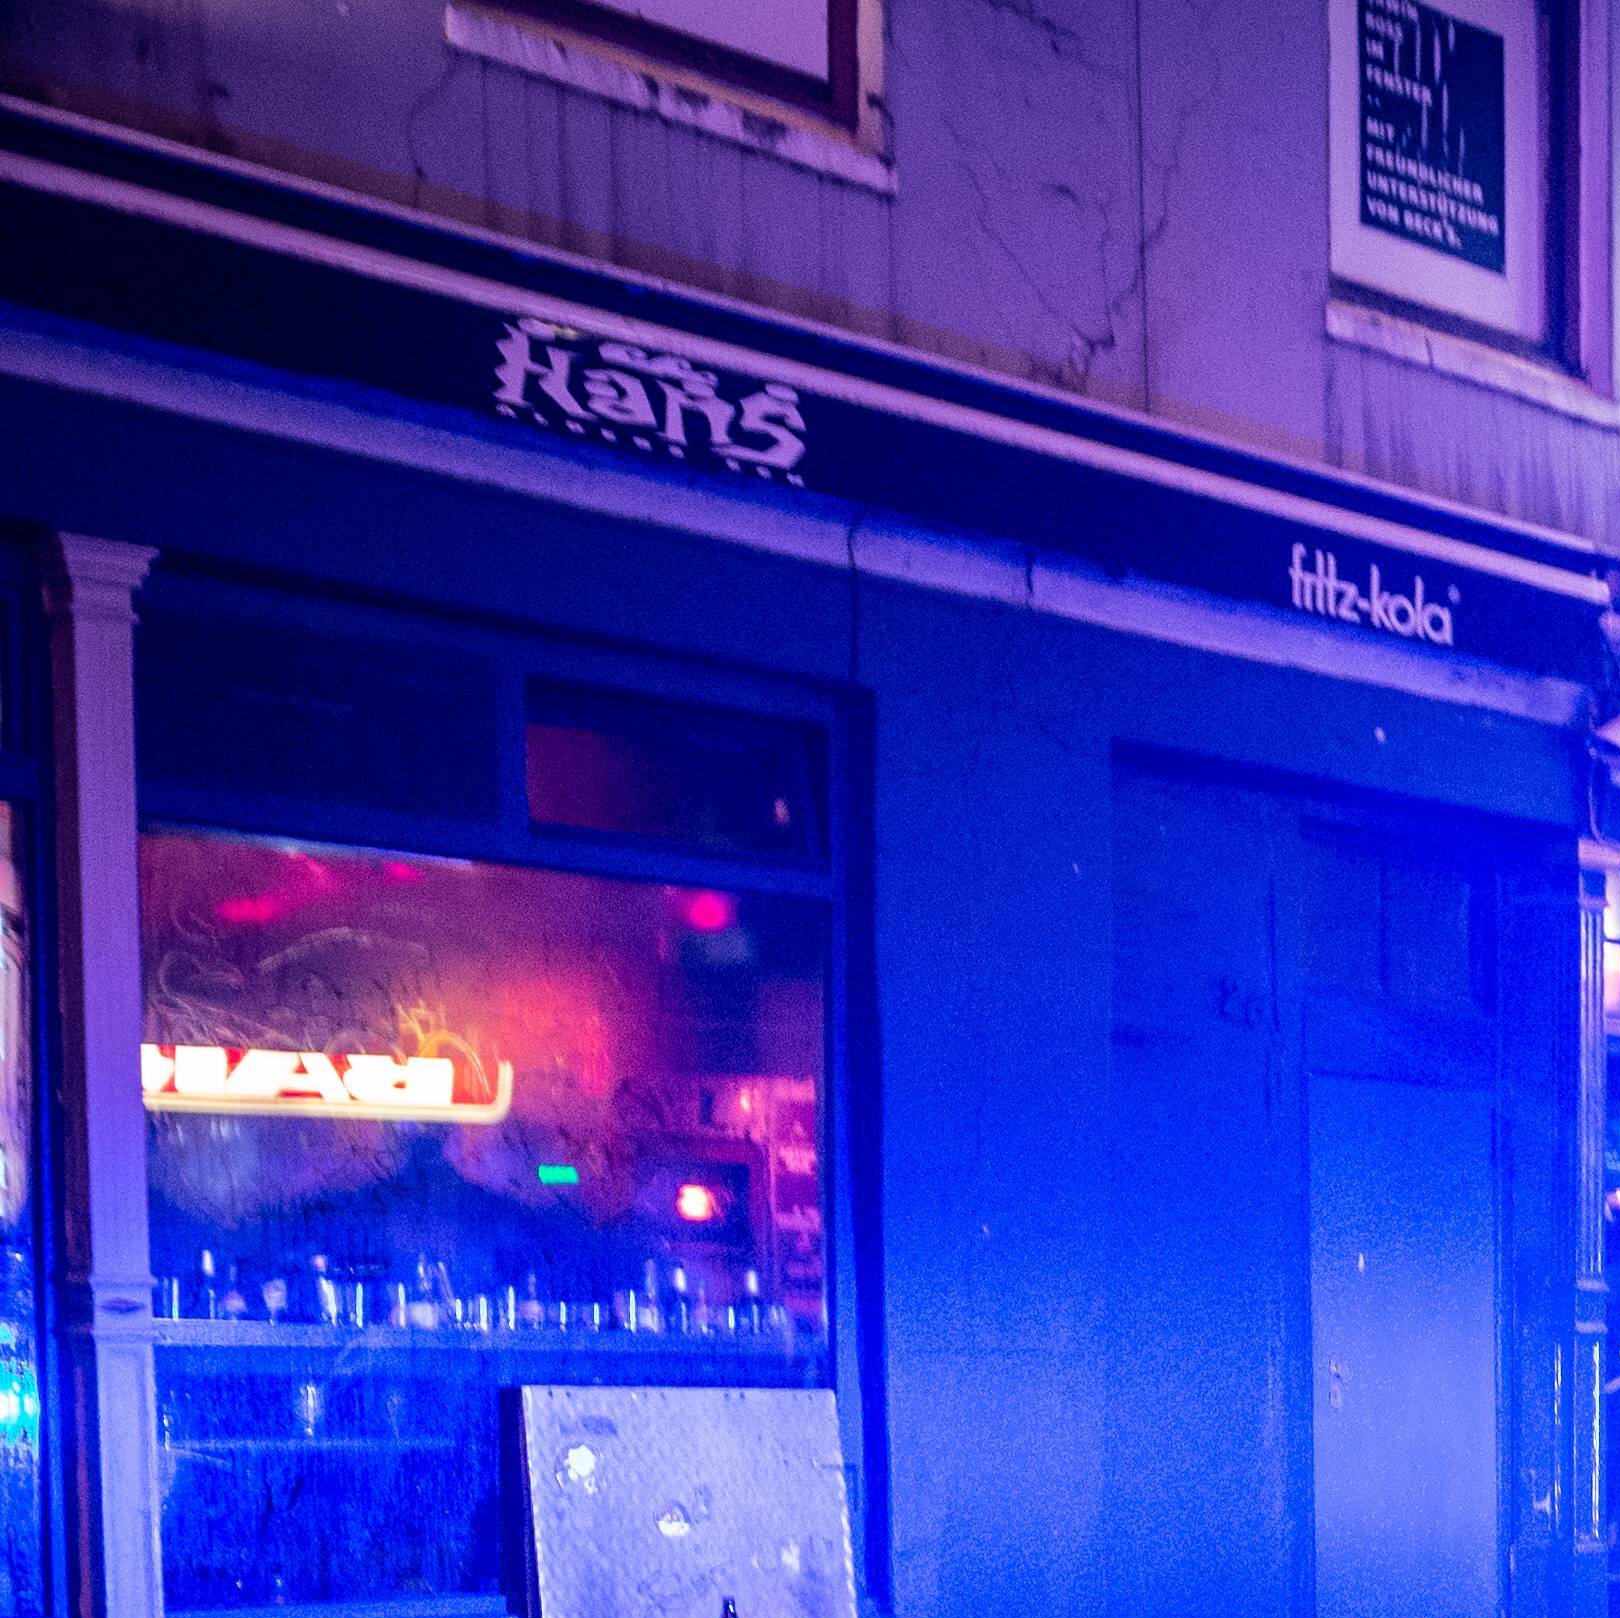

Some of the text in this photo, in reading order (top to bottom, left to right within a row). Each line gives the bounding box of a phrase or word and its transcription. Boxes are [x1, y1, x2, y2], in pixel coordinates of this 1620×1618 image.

[1366, 63, 1433, 108] FENSTER
[1366, 115, 1395, 143] MIT
[1366, 142, 1484, 206] FREUNDLICHER
[1366, 195, 1399, 226] VON
